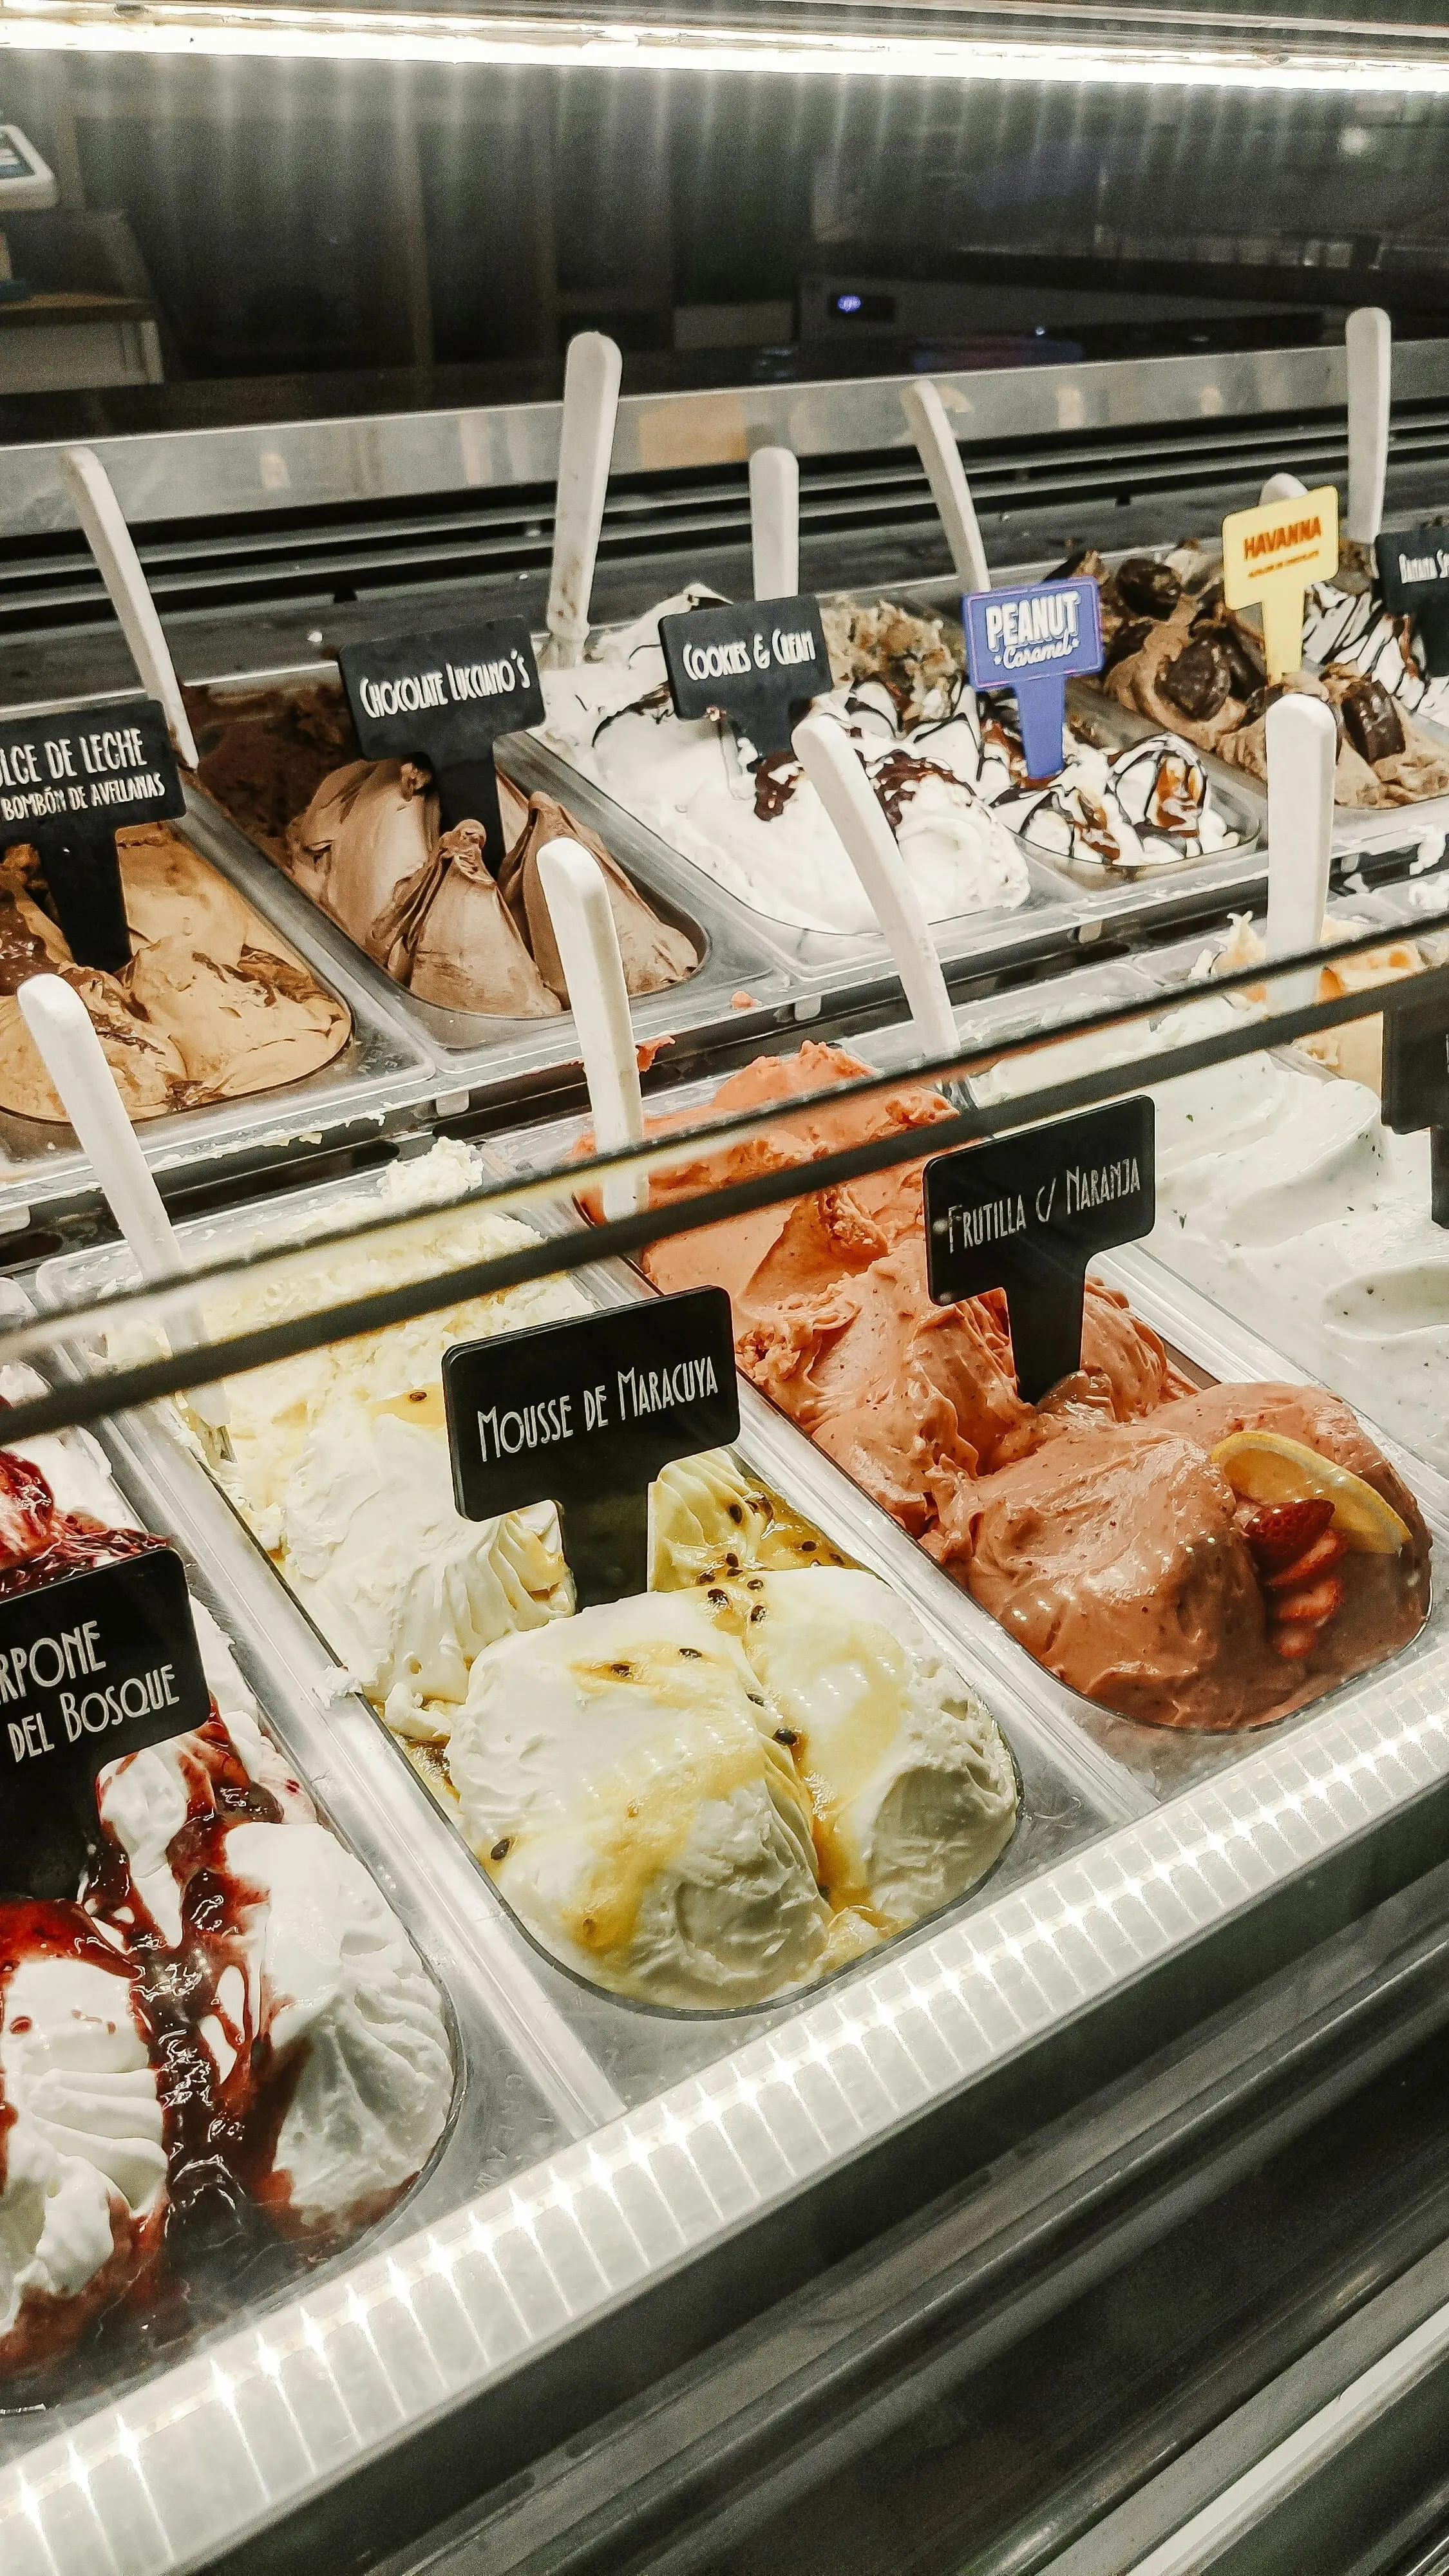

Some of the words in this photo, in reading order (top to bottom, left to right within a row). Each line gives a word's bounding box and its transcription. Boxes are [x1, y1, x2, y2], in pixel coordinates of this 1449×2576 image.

[1244, 516, 1322, 560] HAVANNA
[985, 591, 1080, 652] PEANUT
[1003, 629, 1073, 669] Caramel
[683, 641, 752, 680] COOKIES
[753, 633, 770, 668] &
[772, 628, 816, 665] CREAM
[360, 671, 448, 718] CHOCOLATE
[0, 744, 43, 786] LCE
[44, 739, 78, 779] DE
[79, 728, 147, 773] LECHE
[1, 786, 66, 821] BOMBÓN
[67, 786, 88, 810] DE
[90, 772, 166, 806] AVELLANAS
[948, 1194, 1027, 1254] FRUTILLA
[1066, 1157, 1141, 1215] NARANJA
[477, 1395, 573, 1462] MOUSSE
[583, 1385, 609, 1430] DE
[618, 1356, 718, 1421] MARACUYA
[8, 1712, 55, 1762] DEL
[60, 1664, 180, 1742] BOSQUE
